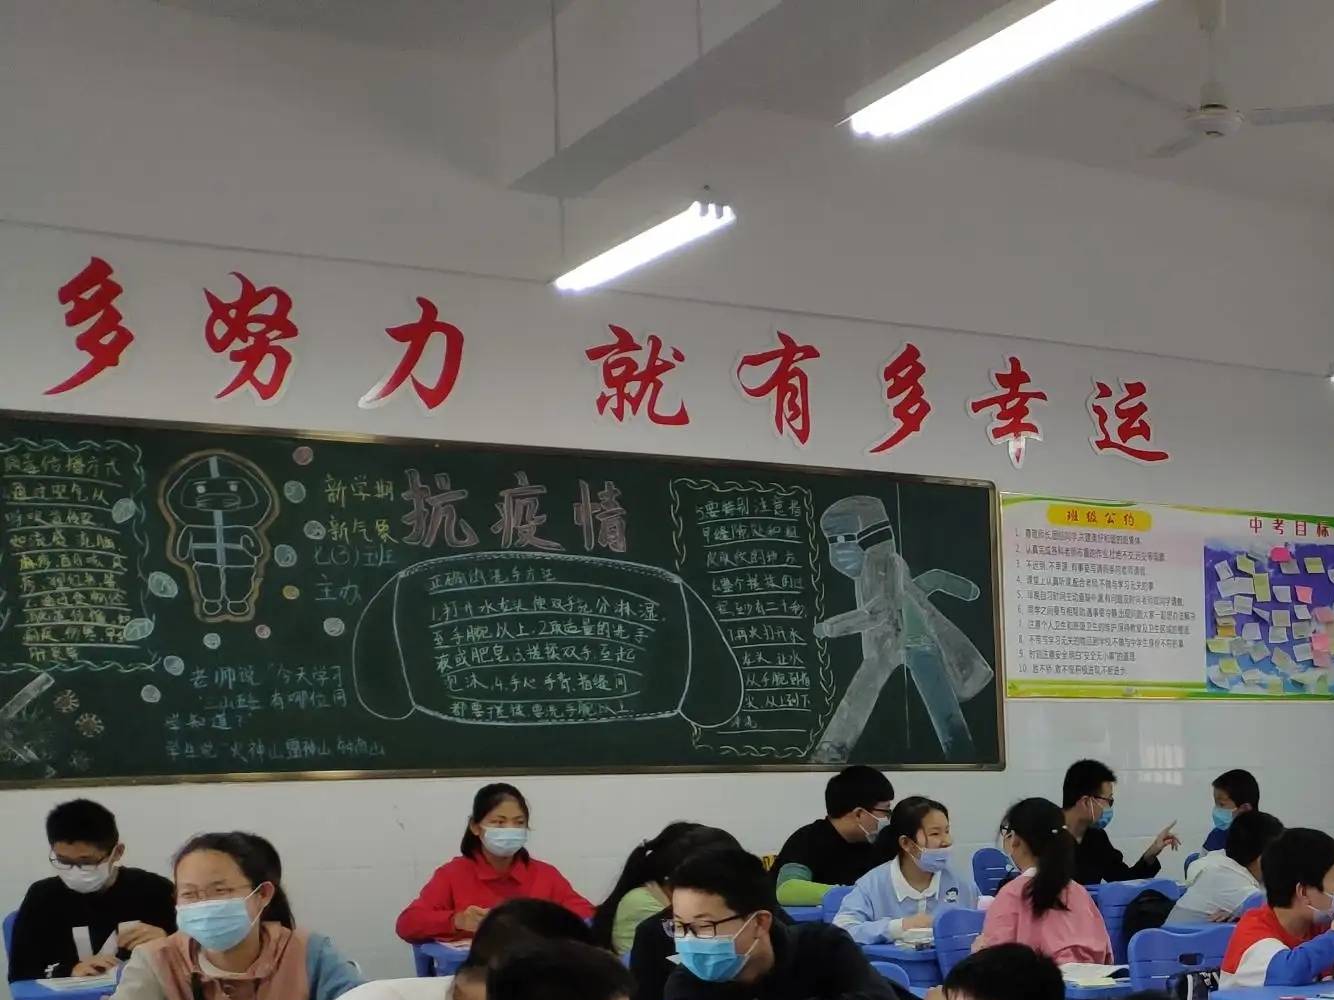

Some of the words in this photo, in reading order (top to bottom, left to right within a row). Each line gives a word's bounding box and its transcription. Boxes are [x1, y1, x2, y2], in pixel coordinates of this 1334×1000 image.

[44, 255, 466, 412] 多努力
[584, 322, 1172, 465] 就有多幸运
[325, 473, 394, 508] 新学期
[400, 468, 628, 553] 抗疫情
[1067, 509, 1136, 527] 班级公约
[327, 514, 399, 544] 新气象
[1249, 516, 1330, 537] 中考目标
[315, 574, 362, 605] 主办
